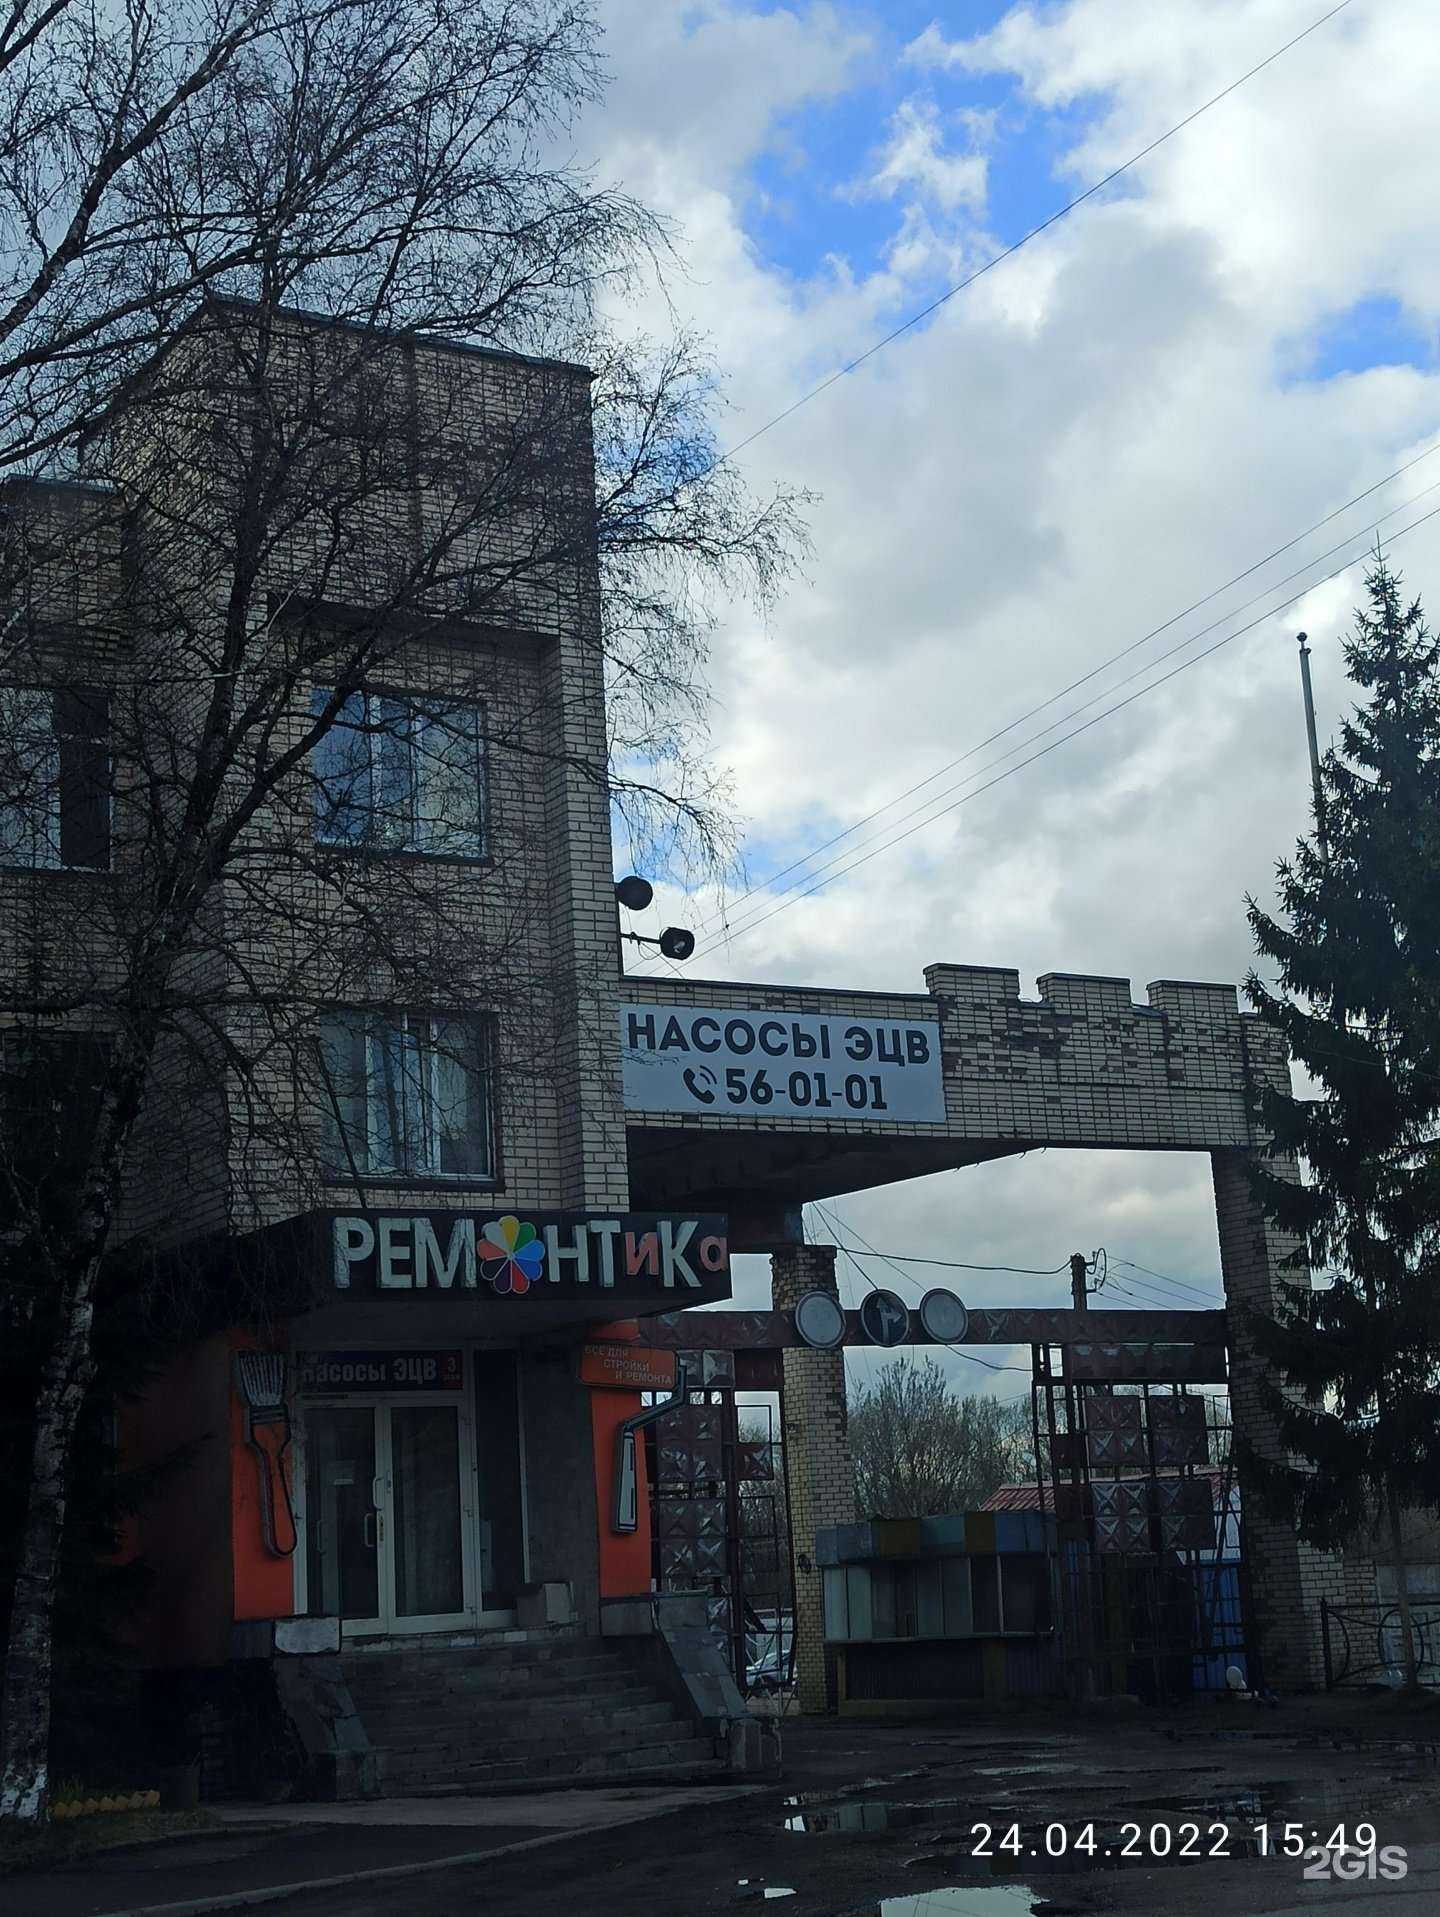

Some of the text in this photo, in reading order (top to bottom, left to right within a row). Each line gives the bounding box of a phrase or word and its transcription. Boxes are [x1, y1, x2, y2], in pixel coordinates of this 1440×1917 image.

[628, 1013, 930, 1067] НАСОСЫ ЭЦВ
[726, 1068, 887, 1110] 56-01-01
[392, 1358, 437, 1384] ЭЦВ
[626, 1372, 673, 1385] РЕМОНТА
